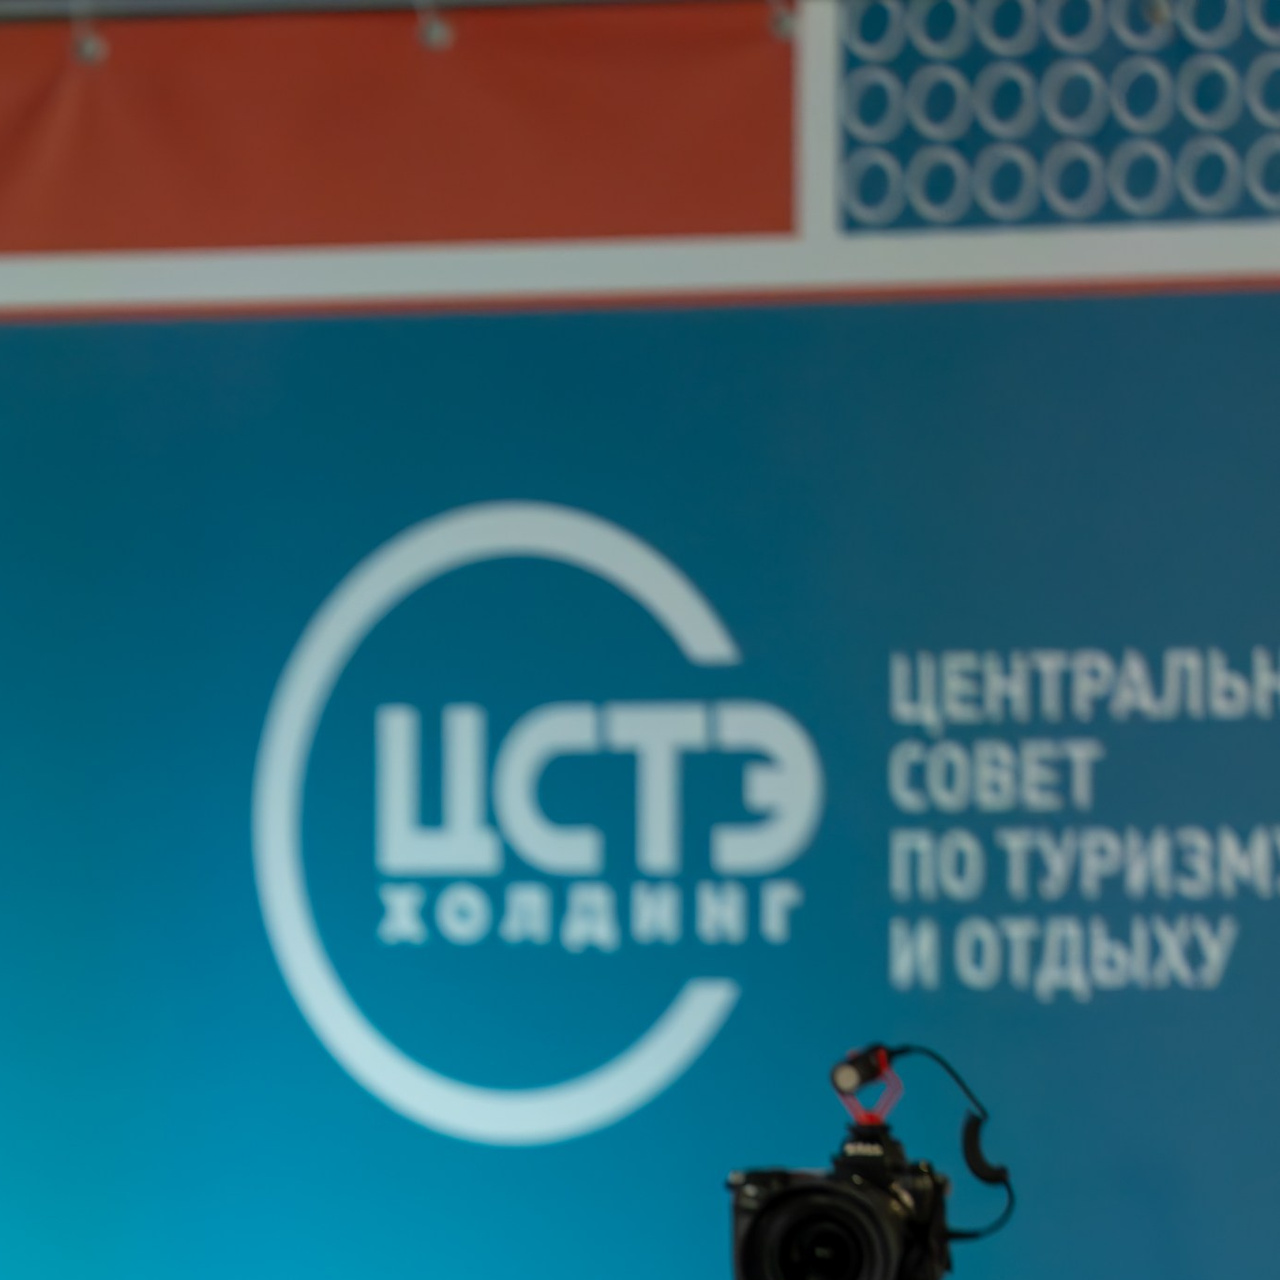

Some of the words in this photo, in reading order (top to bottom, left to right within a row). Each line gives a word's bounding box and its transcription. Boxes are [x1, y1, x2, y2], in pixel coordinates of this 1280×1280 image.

[376, 700, 823, 876] ЦСТЭ
[889, 739, 1104, 811] СОВЕТ
[890, 829, 985, 899] ПО
[379, 881, 803, 953] ХОЛДИНГ
[890, 917, 939, 990] И
[955, 915, 1237, 1002] ОТДЫХУ
